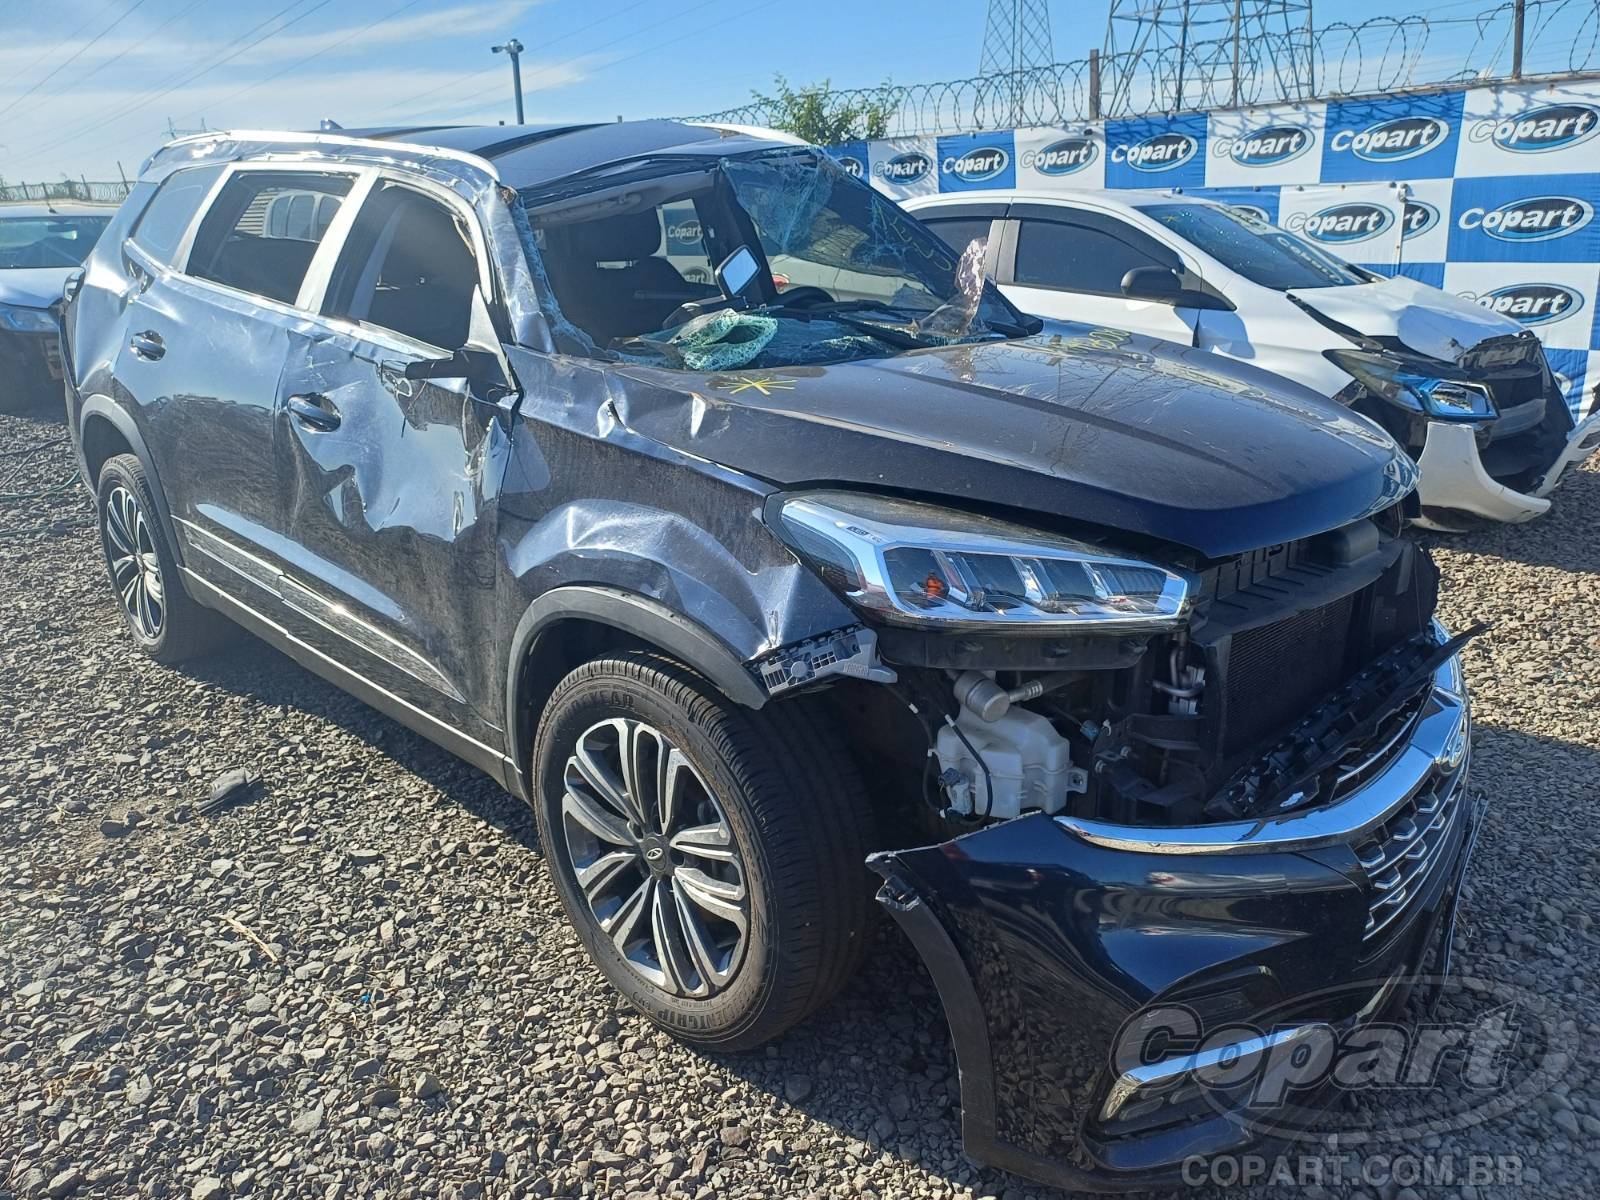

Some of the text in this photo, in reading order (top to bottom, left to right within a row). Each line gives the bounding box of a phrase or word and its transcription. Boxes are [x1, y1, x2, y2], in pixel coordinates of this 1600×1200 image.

[1331, 120, 1437, 152] Copart
[1469, 110, 1592, 144] Copart
[1020, 140, 1090, 168] Copart
[1111, 134, 1188, 162] Copart
[1213, 129, 1302, 159] Copart
[873, 159, 925, 179] Copart
[942, 148, 1001, 175] Copart
[1285, 208, 1381, 236] Copart
[1458, 202, 1582, 232] Copart
[668, 225, 703, 240] Copart
